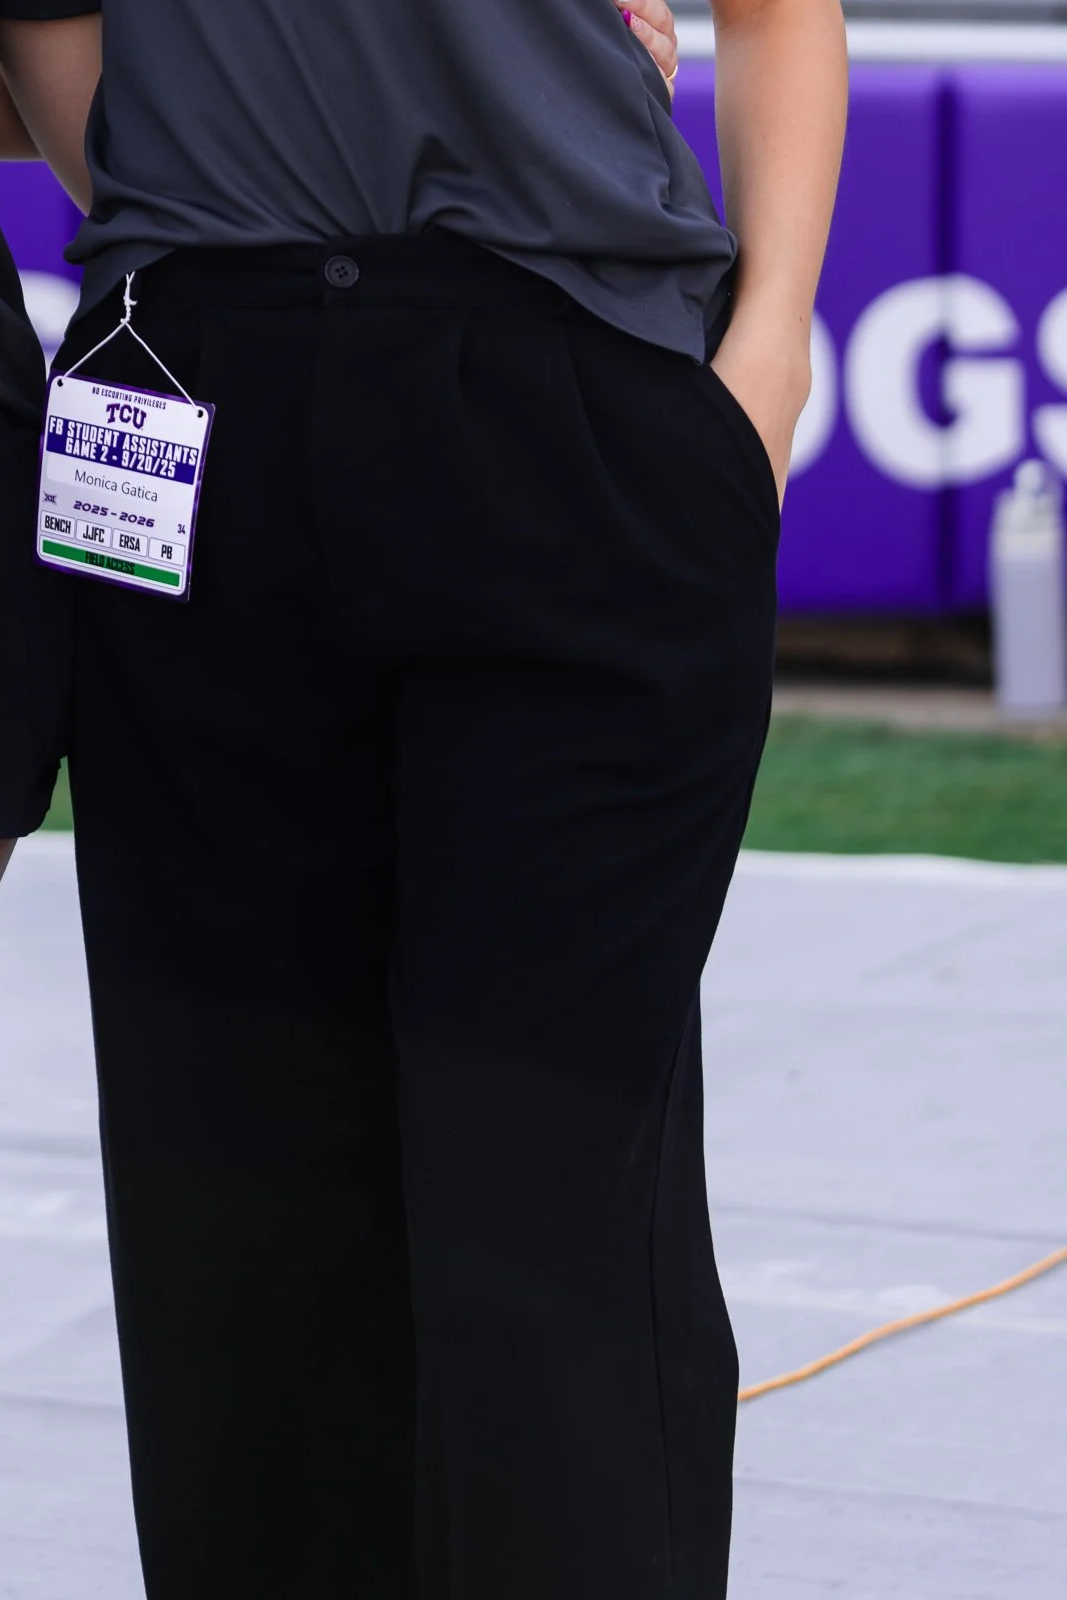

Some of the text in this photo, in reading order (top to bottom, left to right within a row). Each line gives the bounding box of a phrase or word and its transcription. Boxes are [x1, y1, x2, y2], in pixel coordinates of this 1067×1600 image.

[92, 386, 167, 410] NO ESCORTING PRIVILEGES
[106, 402, 147, 430] TCU
[49, 417, 198, 467] FB STUDENT ASSISTANTS
[65, 437, 97, 460] GAME
[100, 446, 109, 462] 2
[121, 450, 177, 479] 9/20/25
[74, 469, 158, 502] Monica Gatica
[44, 515, 72, 535] BENCH
[73, 500, 109, 517] 2025
[119, 511, 156, 528] 2026
[82, 525, 105, 543] JJFC
[177, 524, 186, 535] 34
[119, 534, 140, 552] ERSA
[161, 544, 173, 560] PB
[85, 551, 135, 575] FIELD ACCESS
